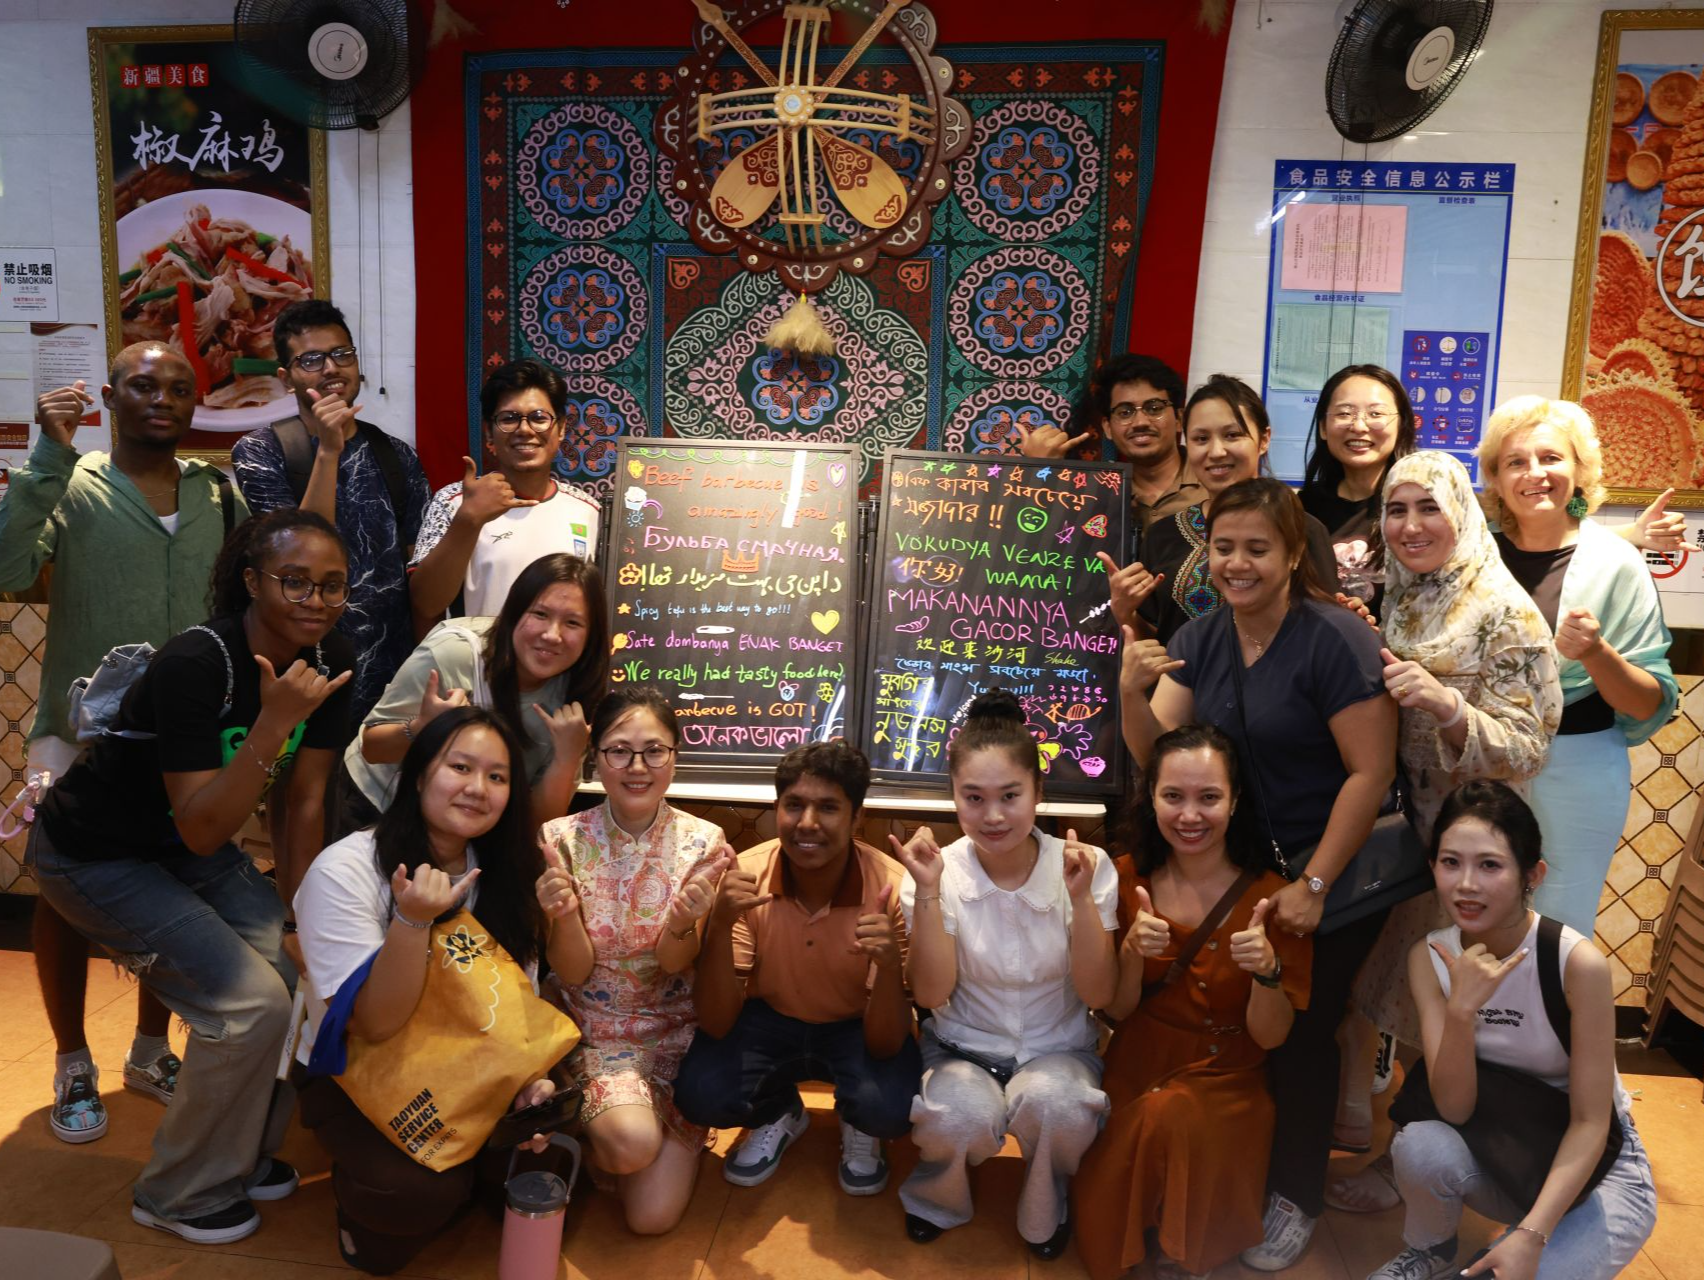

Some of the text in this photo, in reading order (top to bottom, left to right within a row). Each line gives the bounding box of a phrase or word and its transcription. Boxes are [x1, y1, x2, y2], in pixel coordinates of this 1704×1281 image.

[123, 65, 206, 86] 新疆美食
[129, 111, 285, 173] 椒麻鸡
[1289, 168, 1501, 189] 食品安全信息公示栏
[4, 262, 52, 276] 禁止吸烟
[4, 276, 53, 285] NO SMOKING
[644, 465, 820, 493] Beef barbecue is
[687, 504, 778, 528] amazingly
[895, 532, 991, 560] VOKUDYA
[634, 599, 659, 620] Spicy
[688, 605, 697, 614] is
[700, 603, 712, 614] the
[715, 601, 734, 613] best
[753, 603, 762, 613] to
[888, 588, 1070, 628] MAKANANNYA
[625, 630, 844, 656] Sate dombanya ENAK BANGET
[950, 618, 1035, 643] GACOR
[915, 637, 1029, 664] 欢迎来沙河
[624, 660, 651, 682] We
[658, 664, 698, 688] really
[703, 662, 731, 681] had
[735, 664, 778, 688] tasty
[782, 662, 816, 680] food
[675, 702, 738, 718] arbecue
[748, 701, 762, 716] is
[388, 1088, 433, 1131] TAOYUAN
[398, 1102, 439, 1143] SERVICE
[407, 1118, 445, 1154] CENTER
[420, 1149, 436, 1165] FOR
